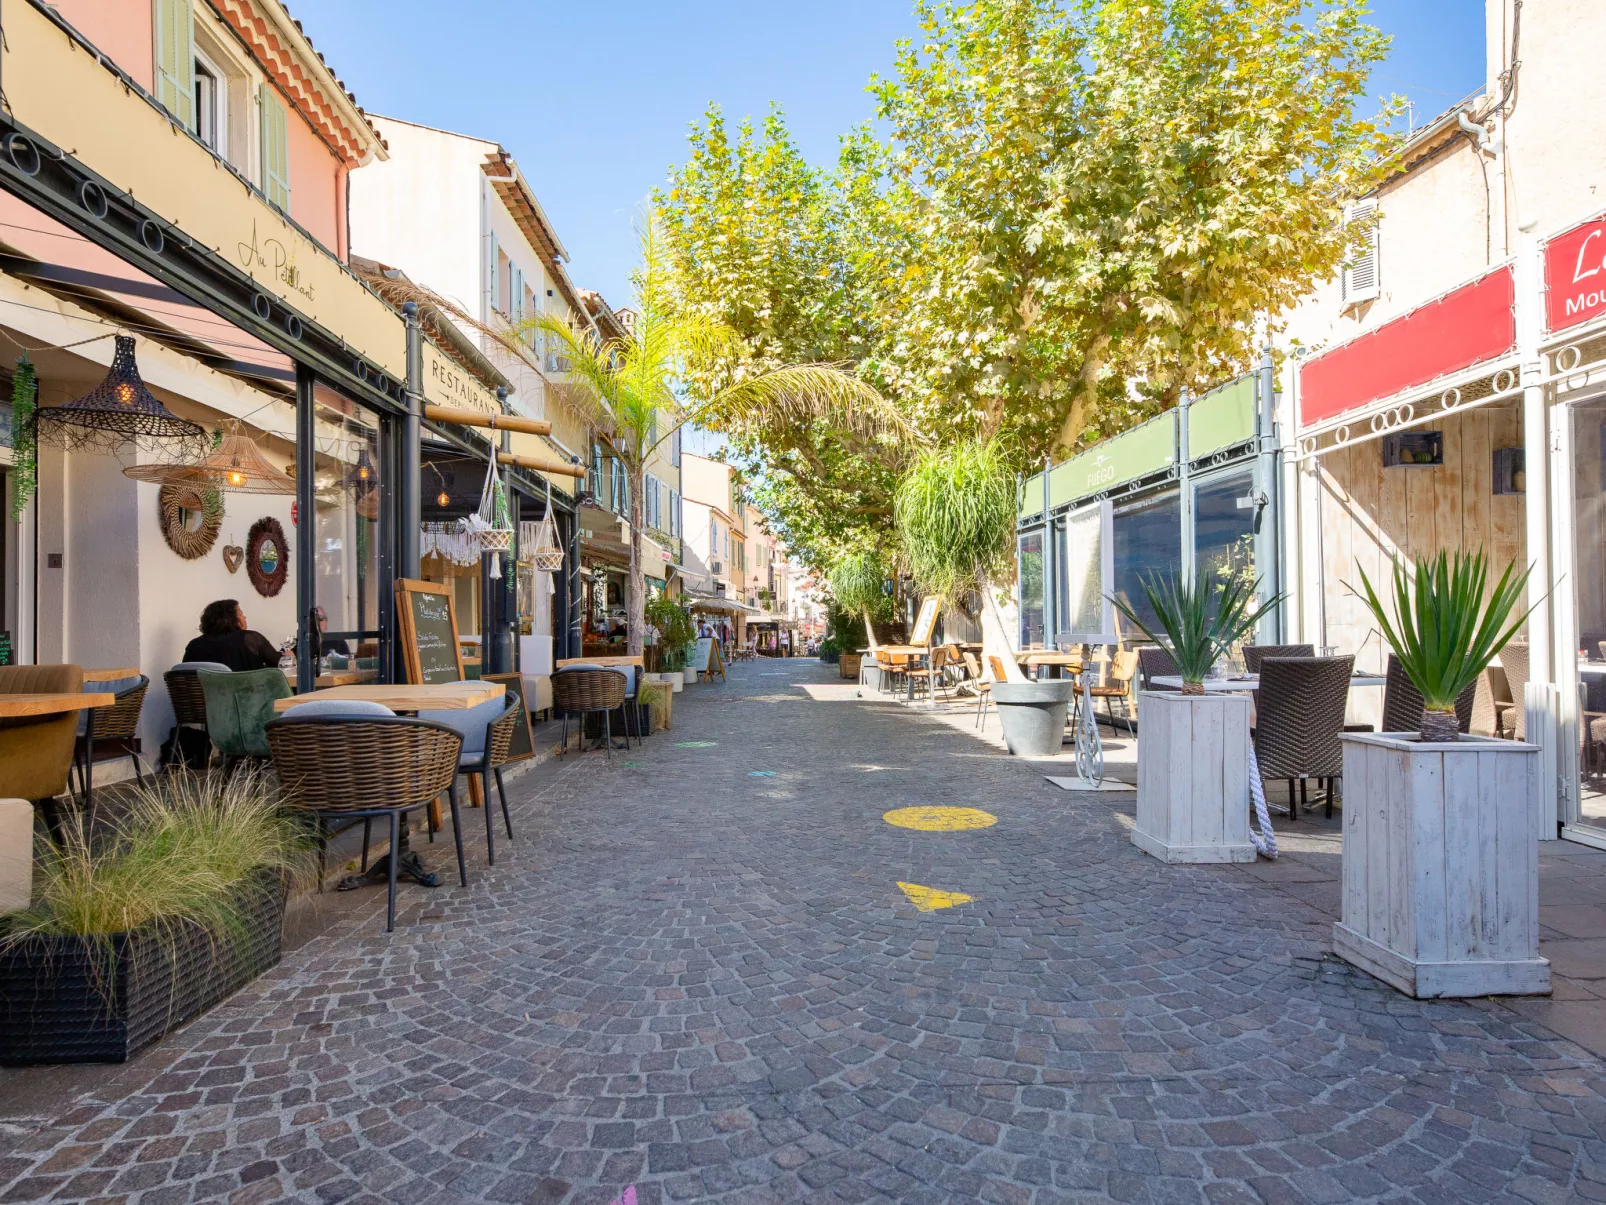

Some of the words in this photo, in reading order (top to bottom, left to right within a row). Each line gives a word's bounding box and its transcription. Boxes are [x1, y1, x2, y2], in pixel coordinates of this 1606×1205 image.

[238, 217, 266, 267] Au
[1572, 229, 1606, 284] L
[1087, 465, 1115, 487] FUEGO
